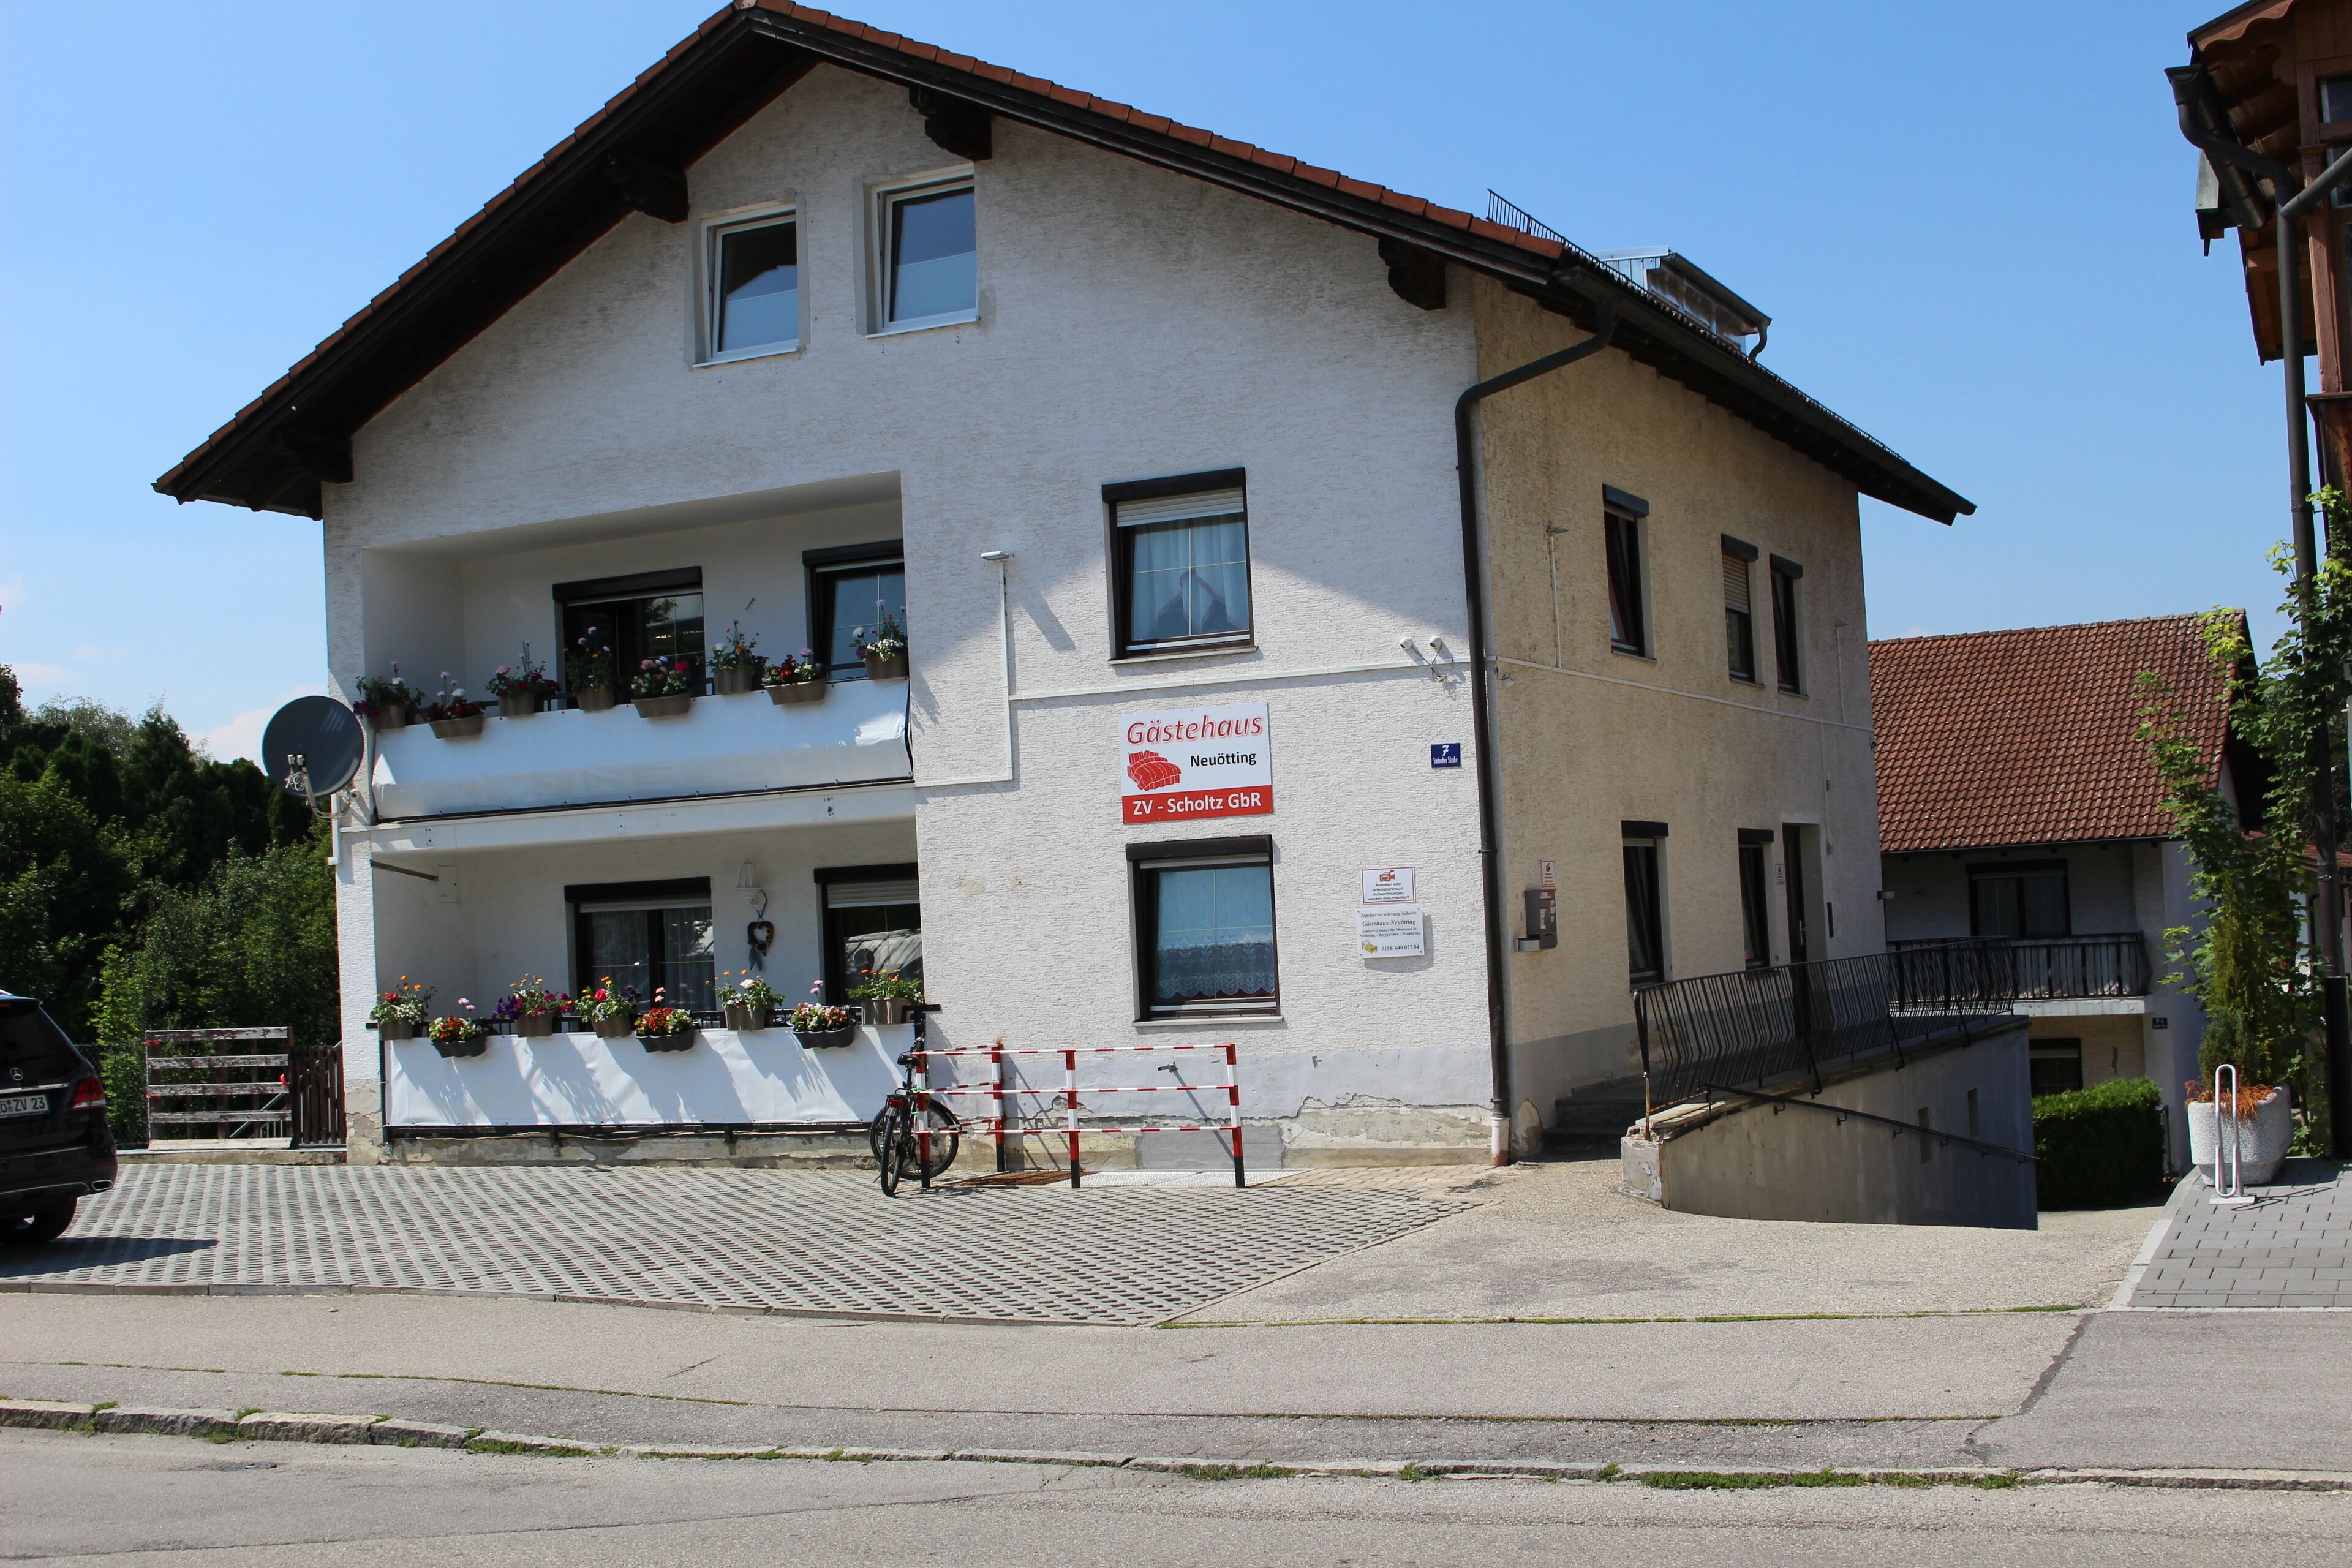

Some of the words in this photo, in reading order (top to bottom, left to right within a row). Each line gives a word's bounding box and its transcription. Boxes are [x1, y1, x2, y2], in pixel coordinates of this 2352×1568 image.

[1127, 715, 1262, 744] Gästehaus
[1442, 745, 1450, 756] 7
[1190, 752, 1256, 767] Neuötting
[1133, 800, 1153, 815] ZV
[1167, 794, 1223, 813] Scholtz
[1227, 792, 1262, 809] GbR
[12, 1098, 27, 1112] ZV
[31, 1097, 45, 1110] 23
